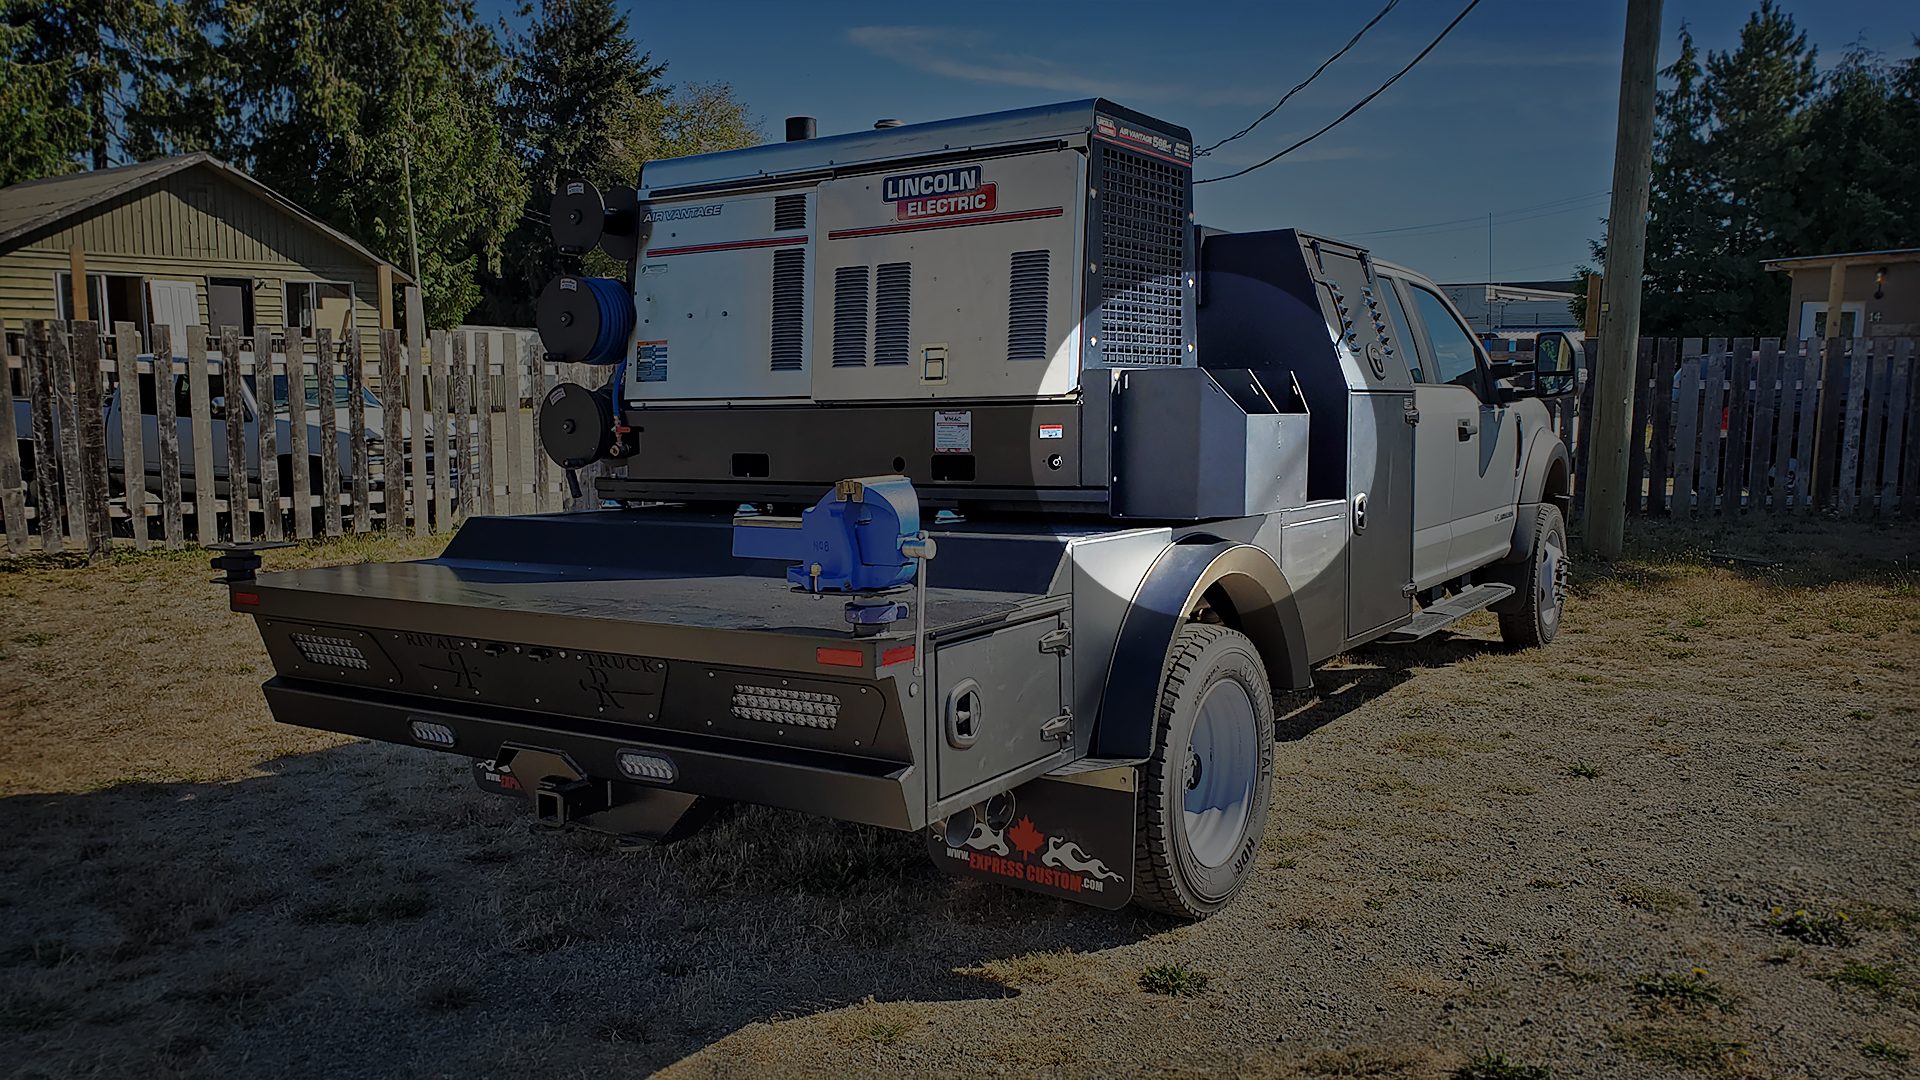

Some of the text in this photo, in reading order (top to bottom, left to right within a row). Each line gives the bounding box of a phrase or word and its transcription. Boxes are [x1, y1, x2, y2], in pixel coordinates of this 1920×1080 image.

[887, 169, 977, 199] LINCOLN
[642, 205, 723, 223] AIR VANTAGE
[907, 193, 988, 217] ELECTRIC
[404, 632, 657, 673] RIVAL TRUCK
